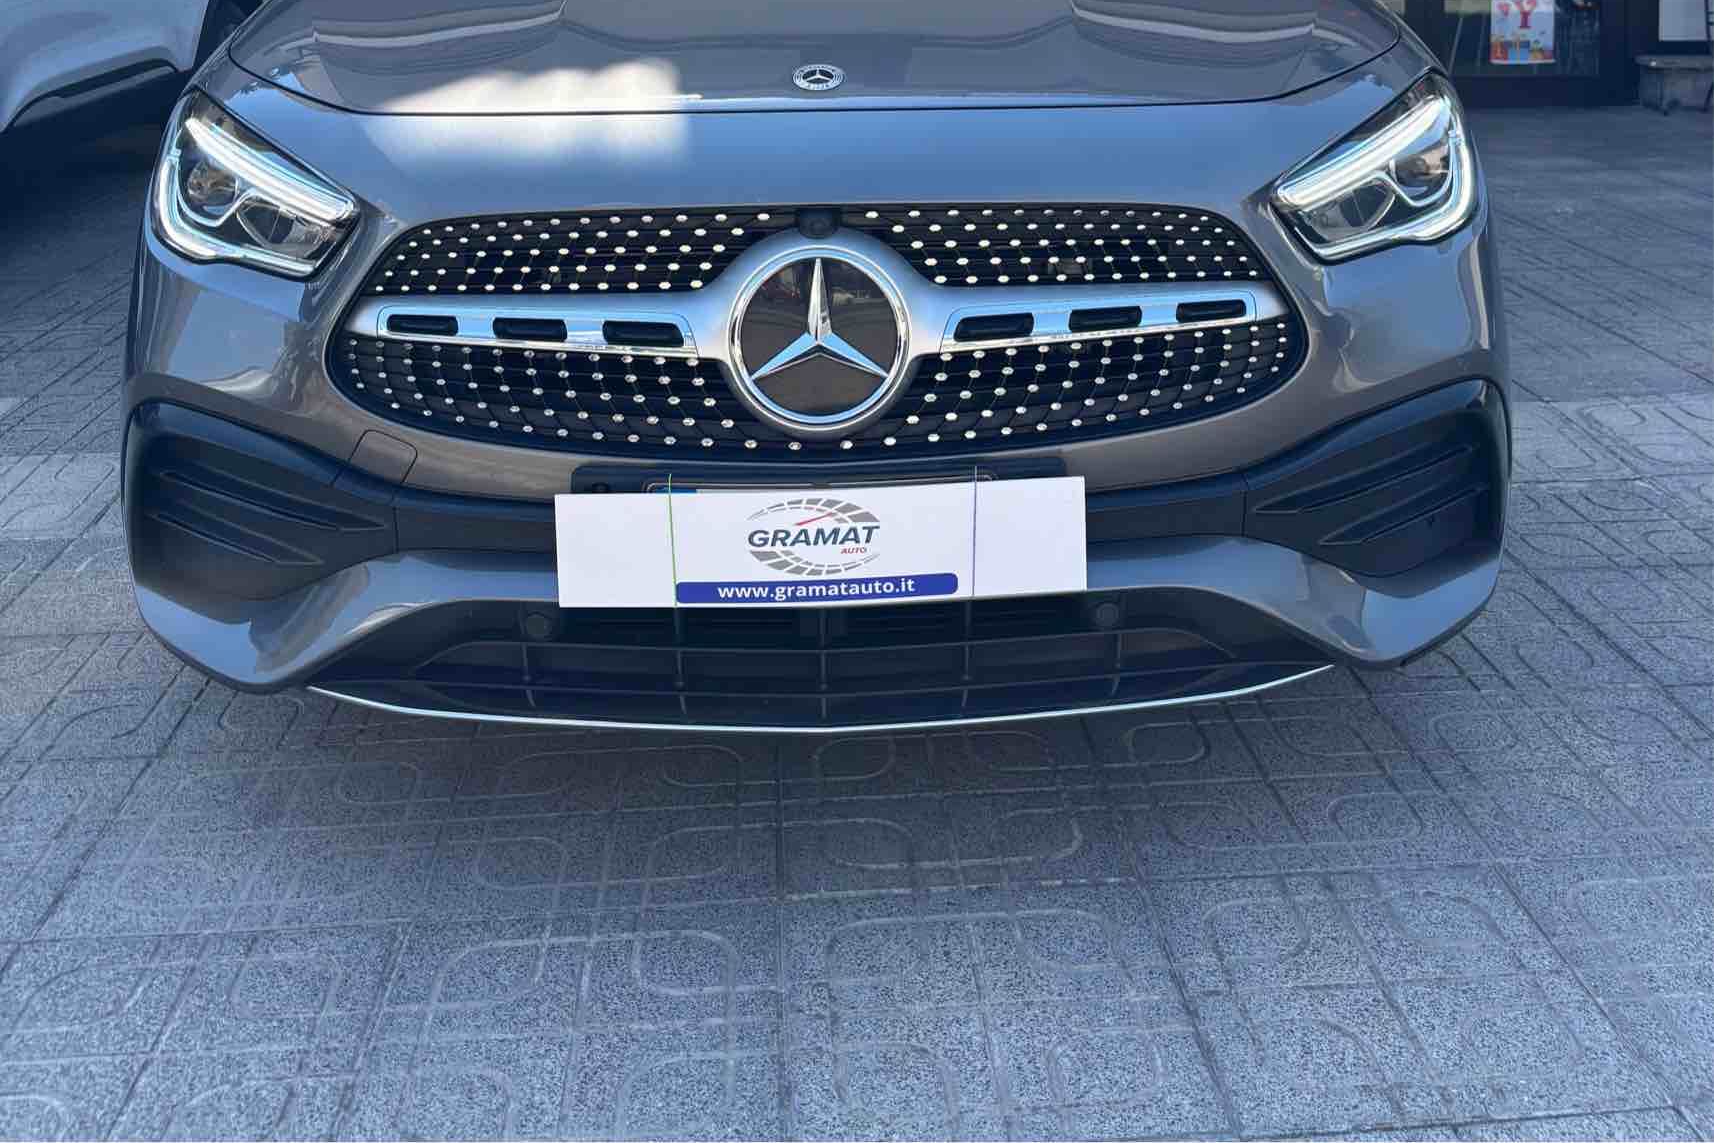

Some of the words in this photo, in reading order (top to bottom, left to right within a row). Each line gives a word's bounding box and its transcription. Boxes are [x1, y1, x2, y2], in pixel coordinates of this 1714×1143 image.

[747, 525, 880, 548] GRAMAT
[840, 546, 868, 555] AUTO
[717, 577, 916, 601] www.gramatauto.it
